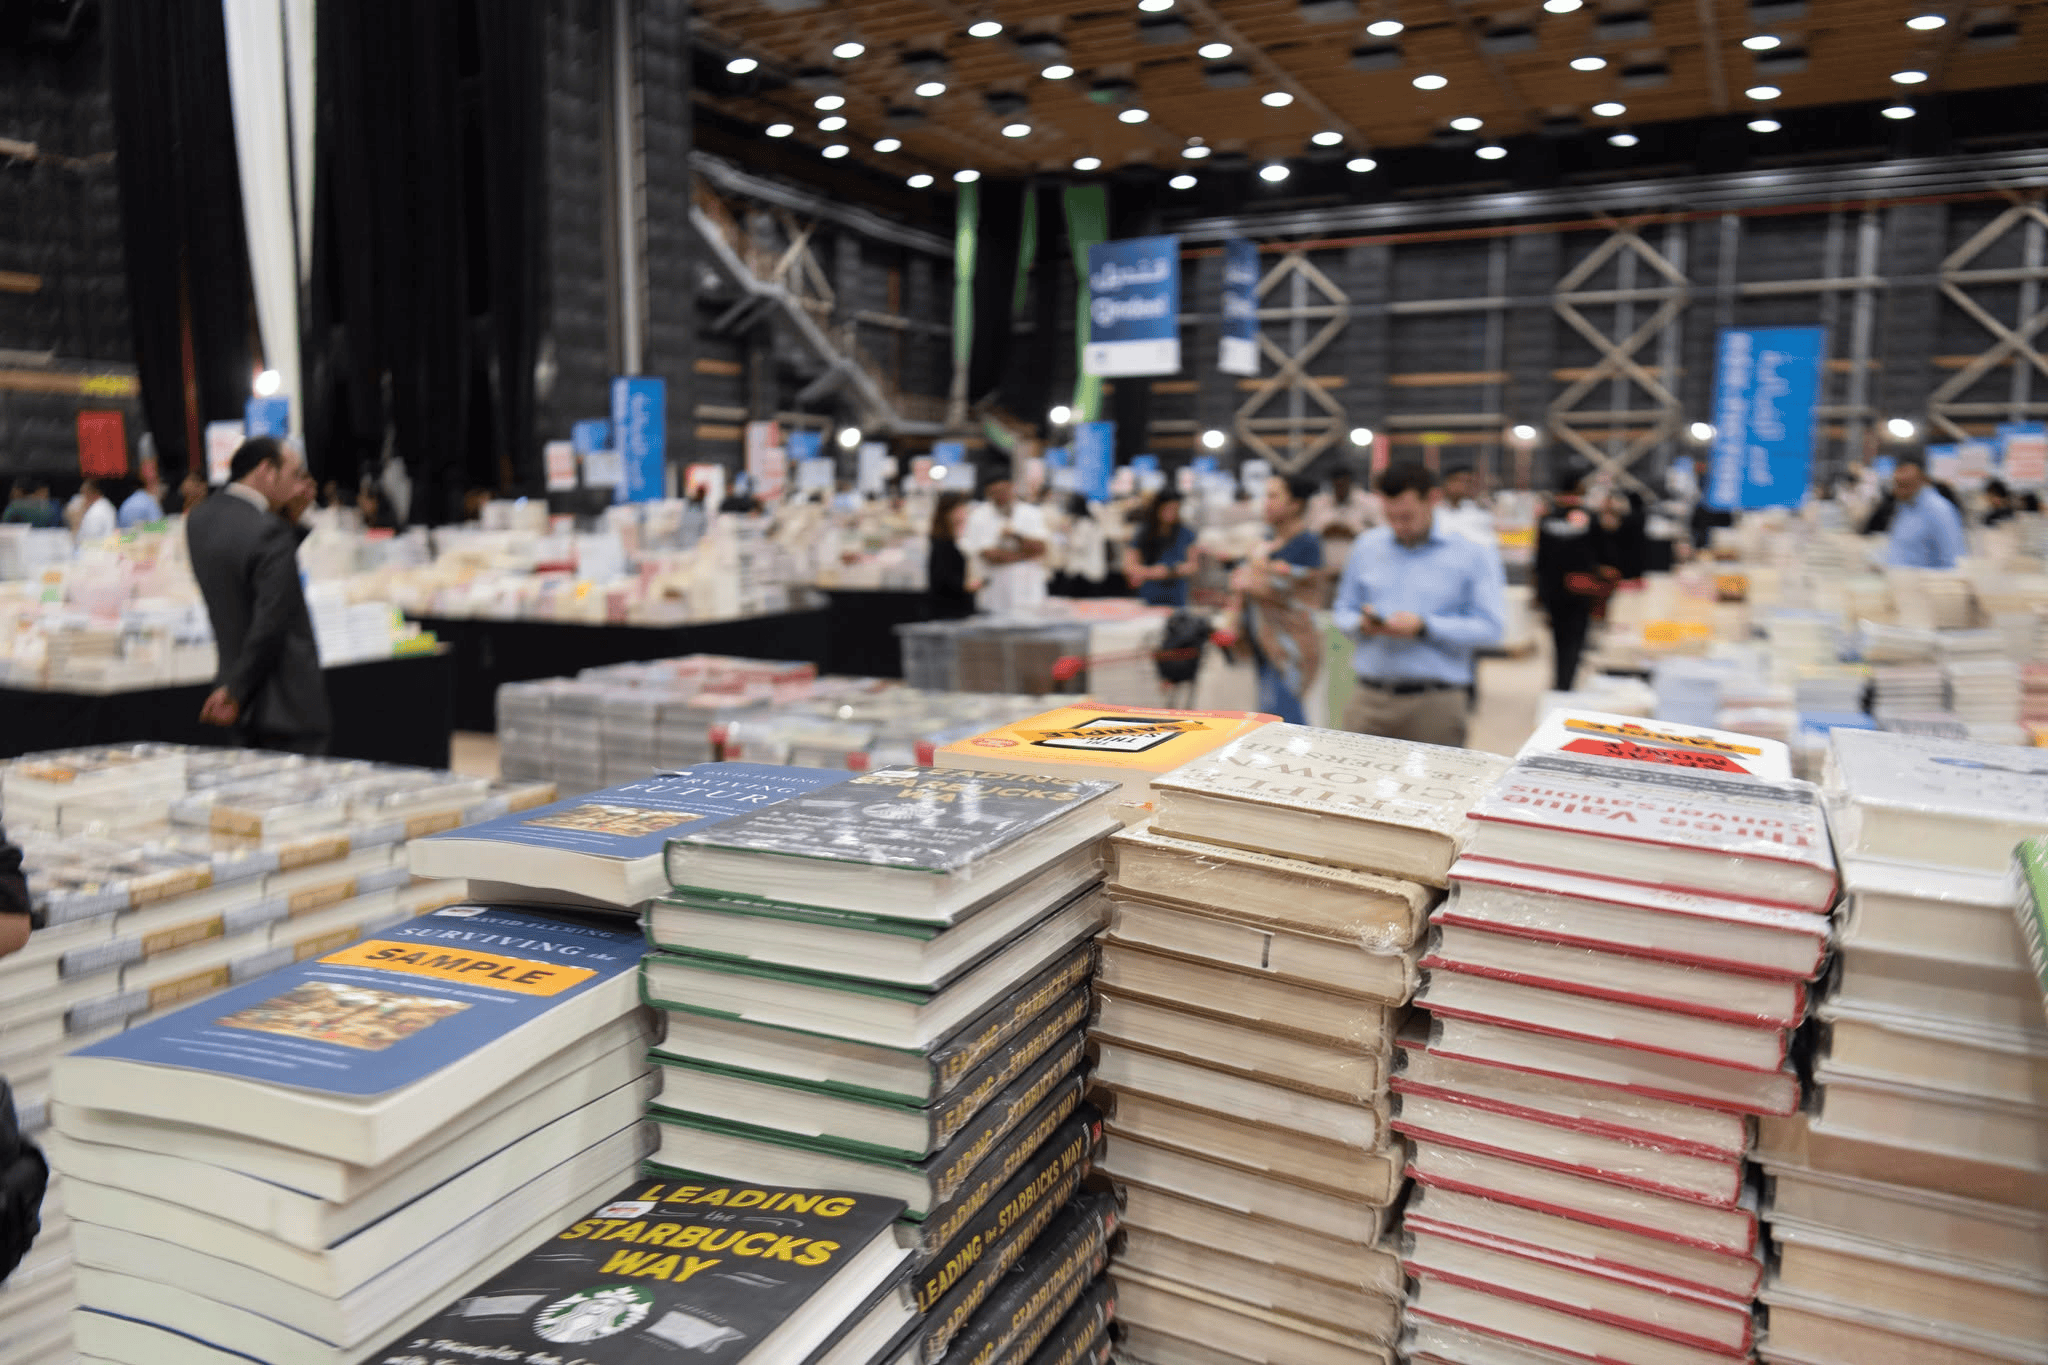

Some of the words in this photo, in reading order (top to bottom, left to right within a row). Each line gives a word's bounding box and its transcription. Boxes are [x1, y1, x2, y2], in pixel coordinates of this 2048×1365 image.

[1039, 725, 1183, 738] SAMPLE
[652, 777, 796, 793] SURVIVING
[904, 767, 1081, 787] LEADING
[1502, 793, 1638, 823] Value
[1508, 784, 1817, 834] Conversations
[1660, 815, 1813, 847] Three
[396, 927, 589, 956] SURVIVING
[526, 922, 616, 938] FLEMING
[364, 948, 557, 985] SAMPLE
[1004, 1110, 1057, 1175] STARBUCKS
[1058, 1088, 1077, 1121] WAY
[636, 1184, 857, 1219] LEADING
[702, 1210, 738, 1225] the
[917, 1234, 983, 1313] LEADING
[984, 1226, 998, 1244] the
[998, 1159, 1060, 1235] STARBUCKS
[1061, 1136, 1083, 1174] WAY
[558, 1218, 841, 1267] STARBUCKS
[1074, 1231, 1096, 1267] WAY
[598, 1249, 724, 1284] WAY
[1074, 1320, 1096, 1357] WAY
